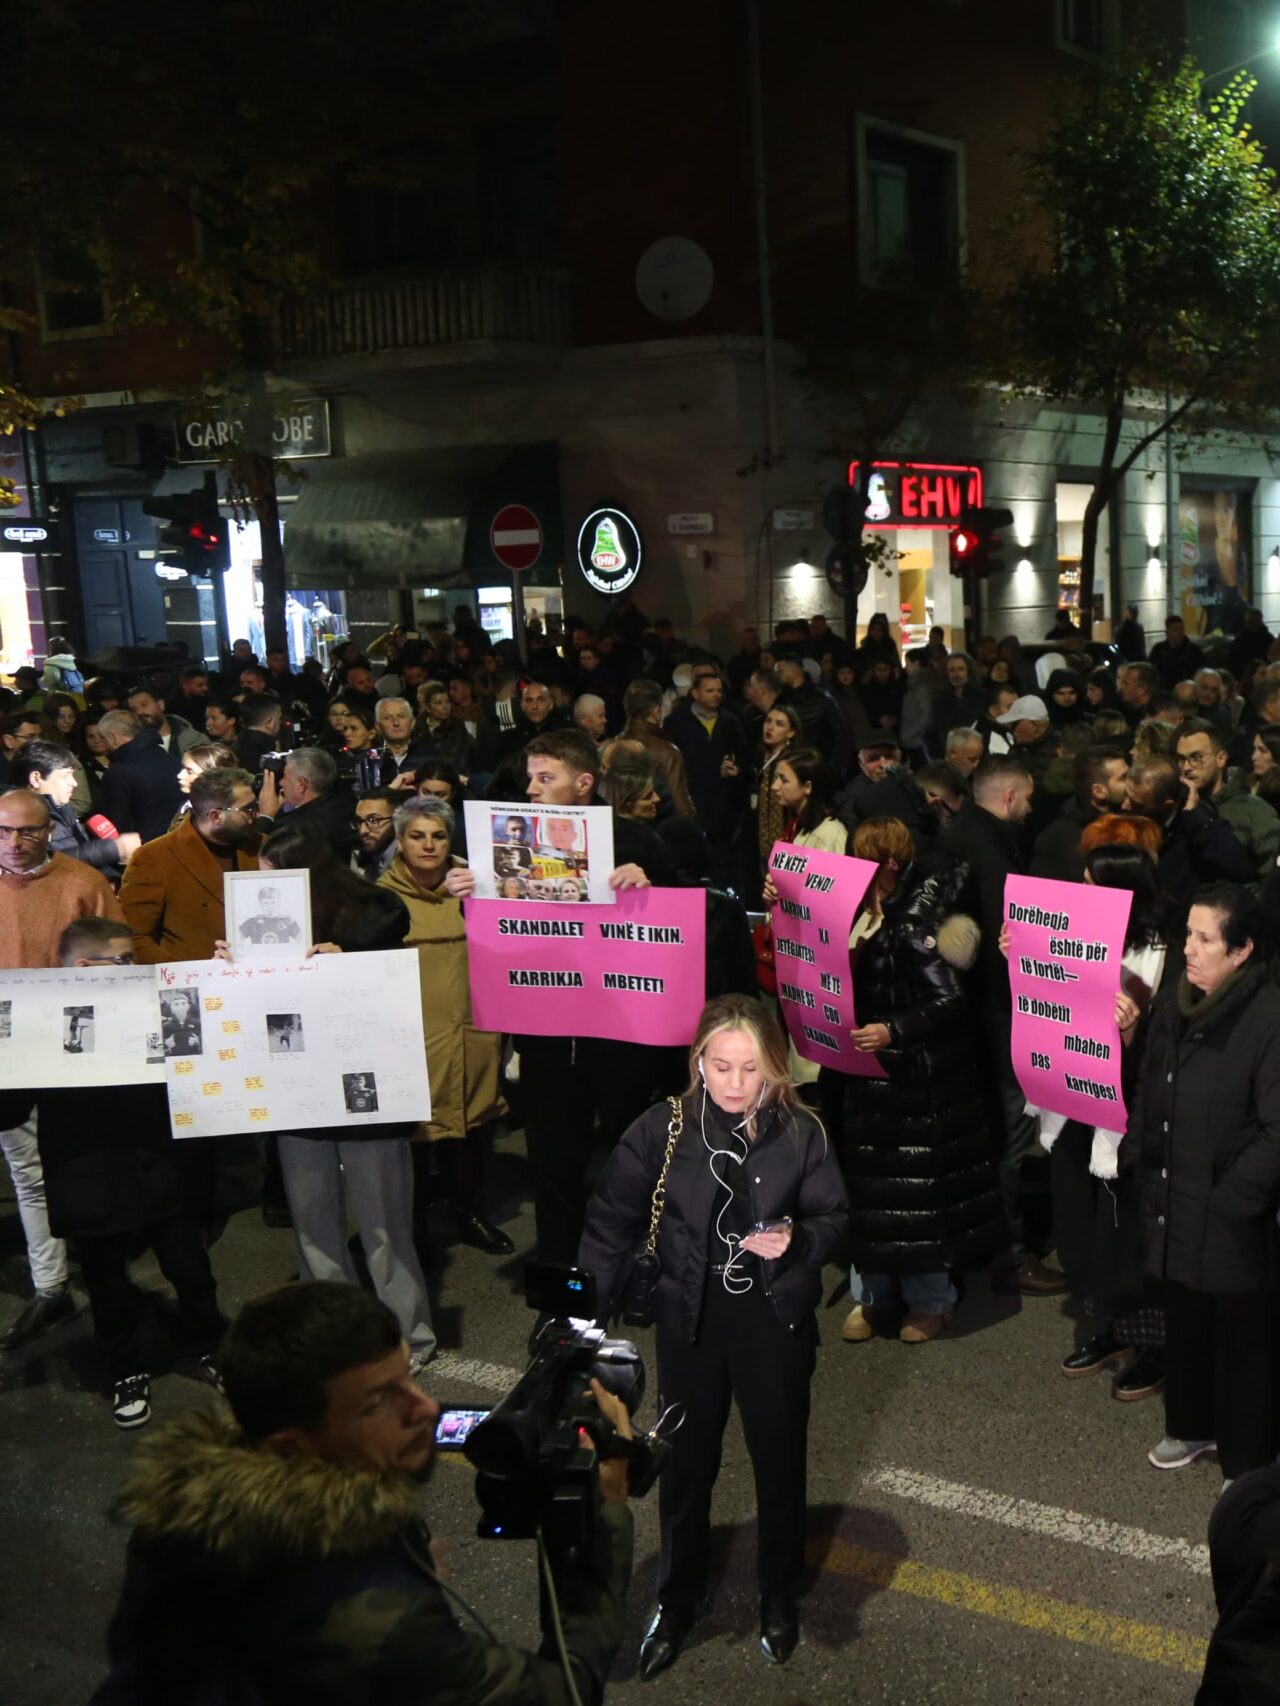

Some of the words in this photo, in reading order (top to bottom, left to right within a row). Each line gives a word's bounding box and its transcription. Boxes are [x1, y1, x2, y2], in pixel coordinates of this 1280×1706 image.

[805, 873, 834, 892] VEND!
[1009, 902, 1069, 931] Dorëheqja
[499, 919, 584, 936] SKANDALET
[600, 922, 633, 940] VINË
[638, 926, 645, 941] E
[649, 927, 684, 944] IKIN.
[1050, 937, 1083, 958] është
[1086, 942, 1107, 961] për
[1021, 957, 1032, 974] të
[509, 970, 583, 987] KARRIKJA
[604, 973, 664, 993] MBETET!
[1018, 994, 1029, 1012] të
[1031, 998, 1070, 1023] dobëtit
[1064, 1035, 1110, 1060] mbahen
[1031, 1052, 1050, 1070] pas
[1065, 1073, 1117, 1101] karriges!
